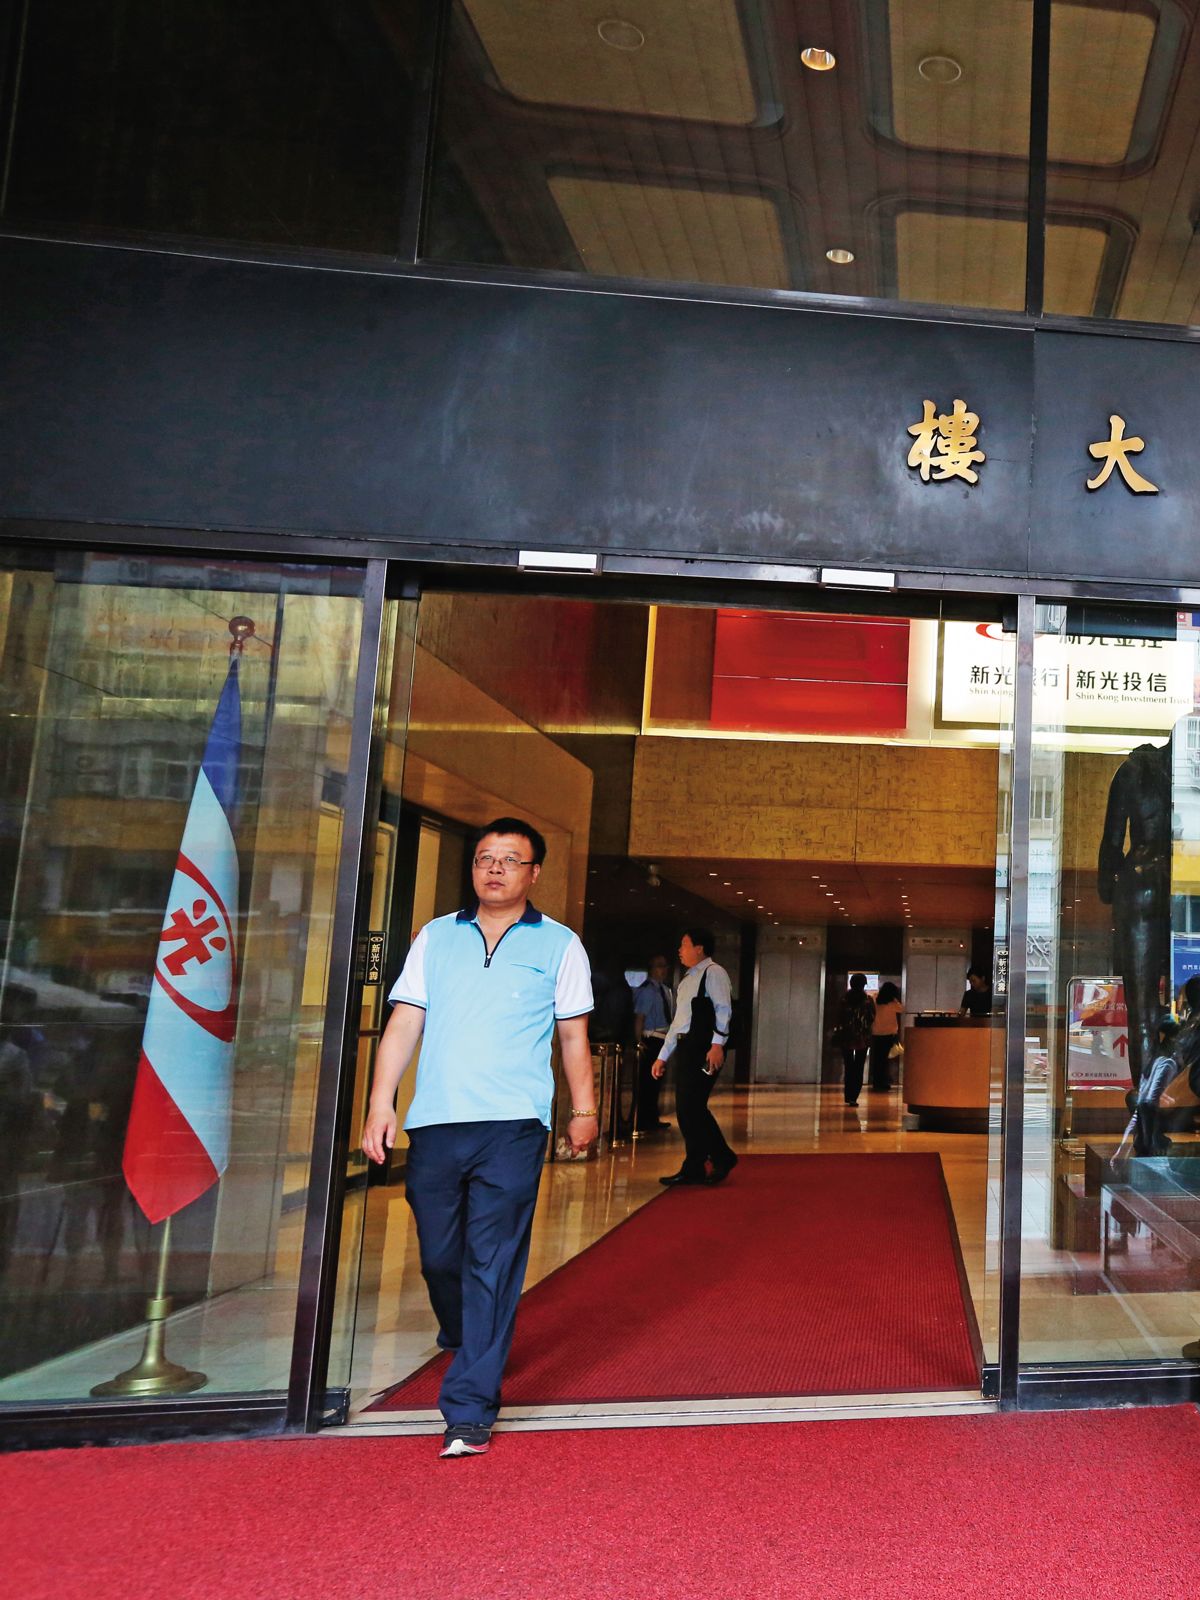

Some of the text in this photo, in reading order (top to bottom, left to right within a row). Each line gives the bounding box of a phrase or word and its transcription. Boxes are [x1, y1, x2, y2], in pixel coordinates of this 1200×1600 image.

[970, 665, 1059, 687] 新光行
[1076, 670, 1167, 692] 新光投信
[1075, 691, 1095, 700] Shin
[1097, 693, 1119, 703] Kong
[1121, 694, 1167, 704] Investment
